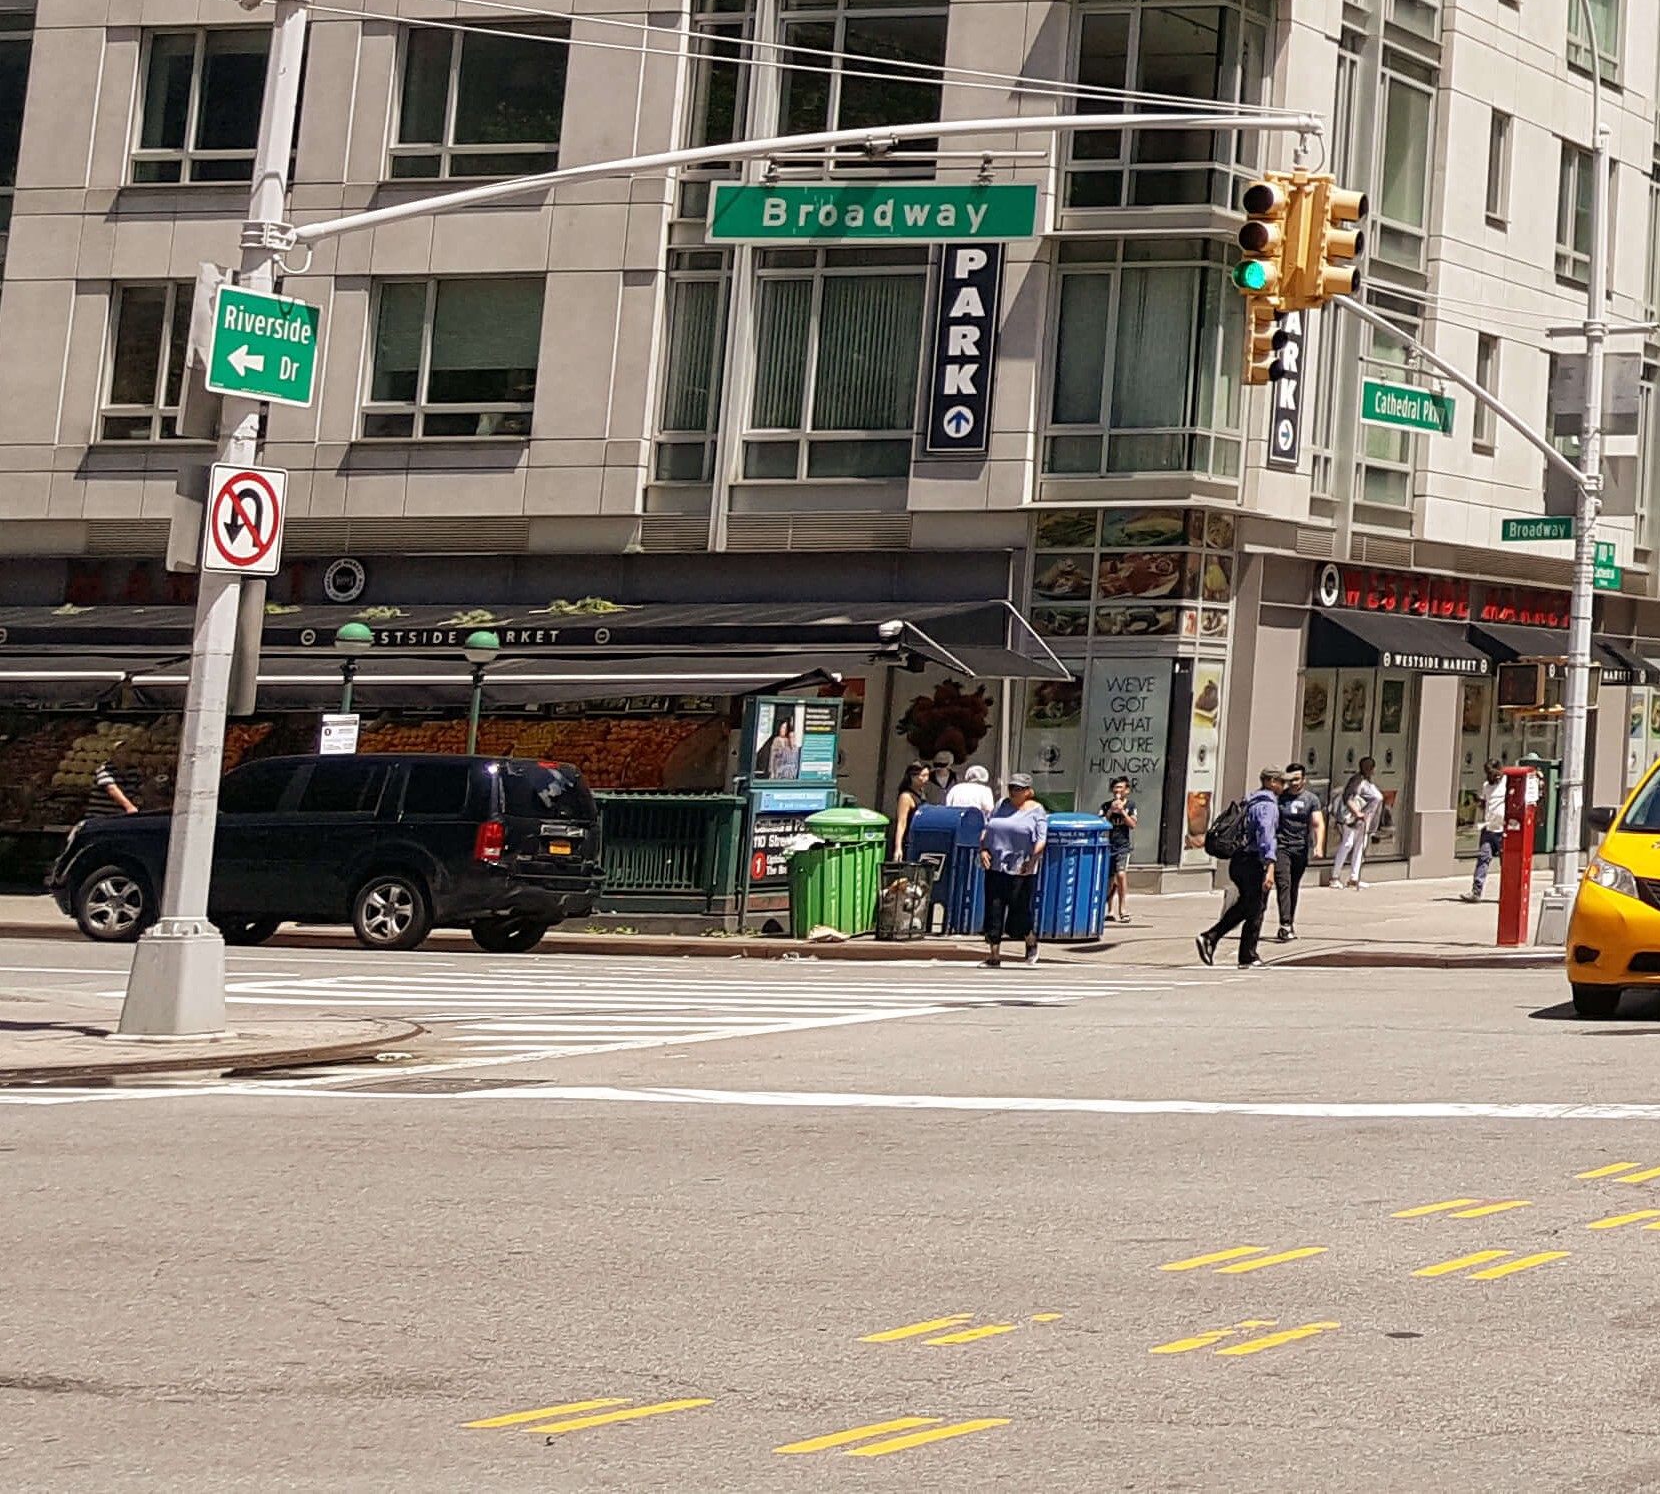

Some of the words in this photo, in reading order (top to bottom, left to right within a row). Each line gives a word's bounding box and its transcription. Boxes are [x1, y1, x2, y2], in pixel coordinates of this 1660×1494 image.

[762, 198, 988, 234] Broadway
[224, 305, 311, 344] Riverside
[943, 249, 988, 395] PARK
[279, 355, 299, 382] Dr
[1279, 310, 1302, 410] ARK
[1375, 391, 1421, 421] Cathedral
[1508, 521, 1566, 538] Broadway
[369, 631, 457, 644] ESTSIDE
[505, 630, 560, 643] RKET
[1394, 655, 1440, 670] WESTSIDE
[1442, 658, 1477, 672] MARKET
[1111, 696, 1148, 713] GOT
[1102, 716, 1153, 732] WHAT
[1099, 736, 1154, 754] YOU'RE
[1089, 757, 1161, 774] HUNGRY
[753, 835, 766, 849] 110
[755, 857, 762, 875] 1
